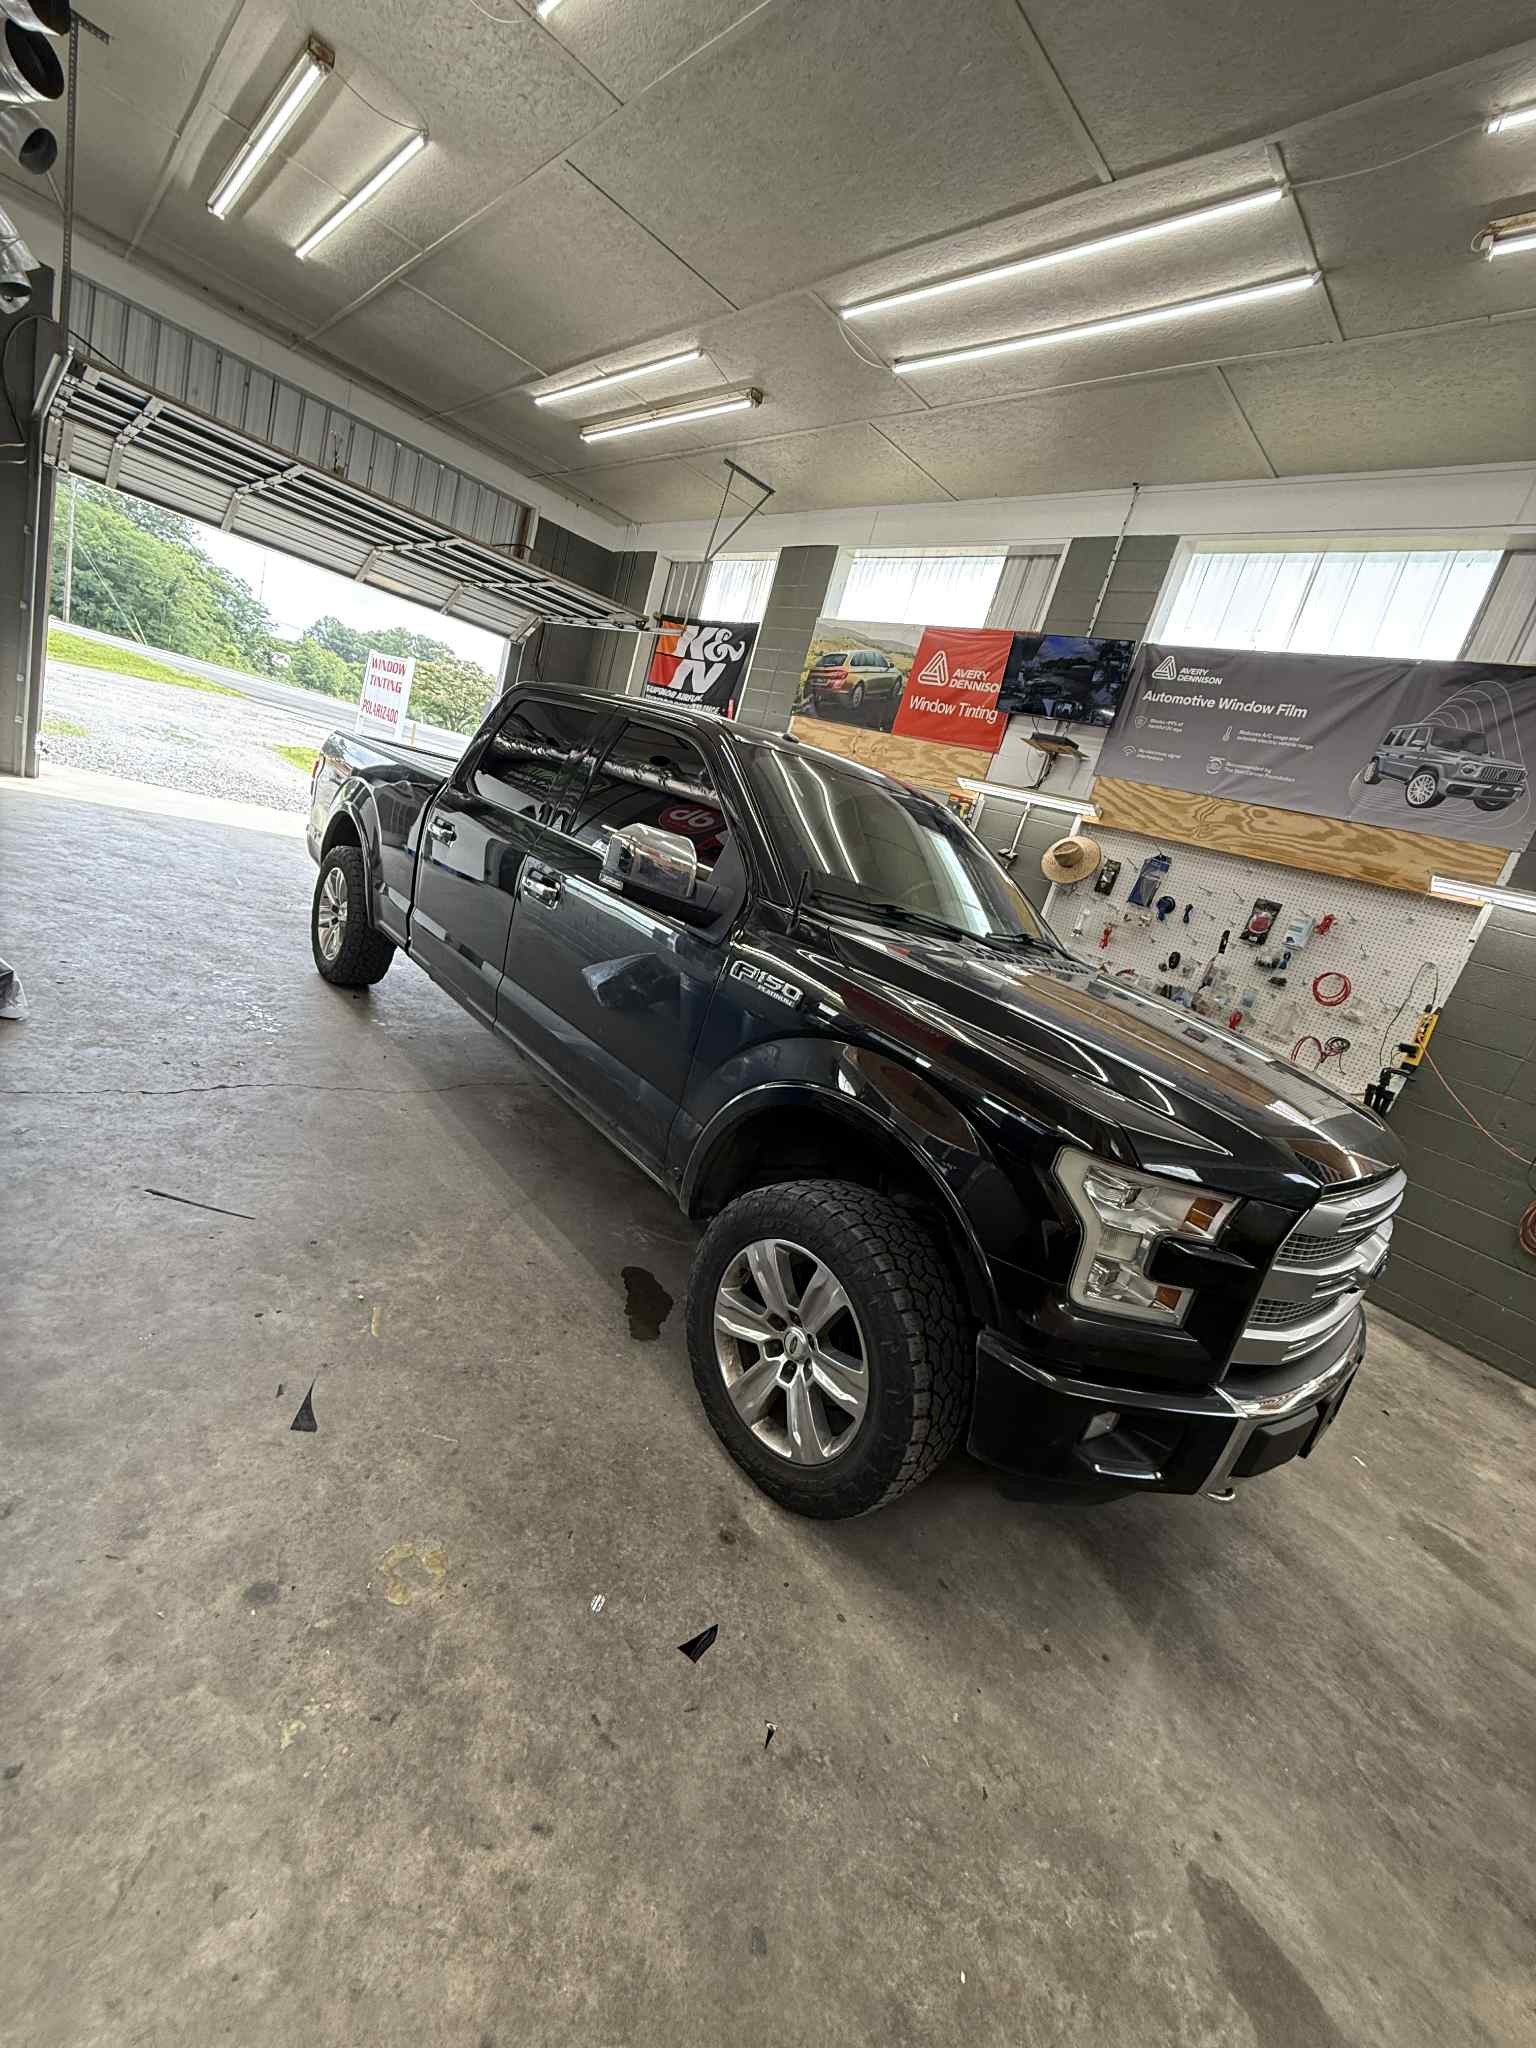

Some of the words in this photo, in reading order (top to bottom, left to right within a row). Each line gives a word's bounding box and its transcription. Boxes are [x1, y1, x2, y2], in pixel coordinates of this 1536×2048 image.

[372, 657, 405, 676] WINDOW
[952, 668, 991, 681] AVERY
[1179, 667, 1209, 676] AVERY
[370, 674, 402, 694] TINTING
[949, 679, 1001, 693] DENNISO
[1177, 674, 1223, 686] DENNISON
[361, 699, 398, 724] POLARIZADO
[909, 695, 957, 715] Window
[958, 702, 998, 725] Tinting
[1142, 690, 1216, 708] Automotive
[1219, 697, 1275, 714] Window
[1275, 703, 1309, 718] Film
